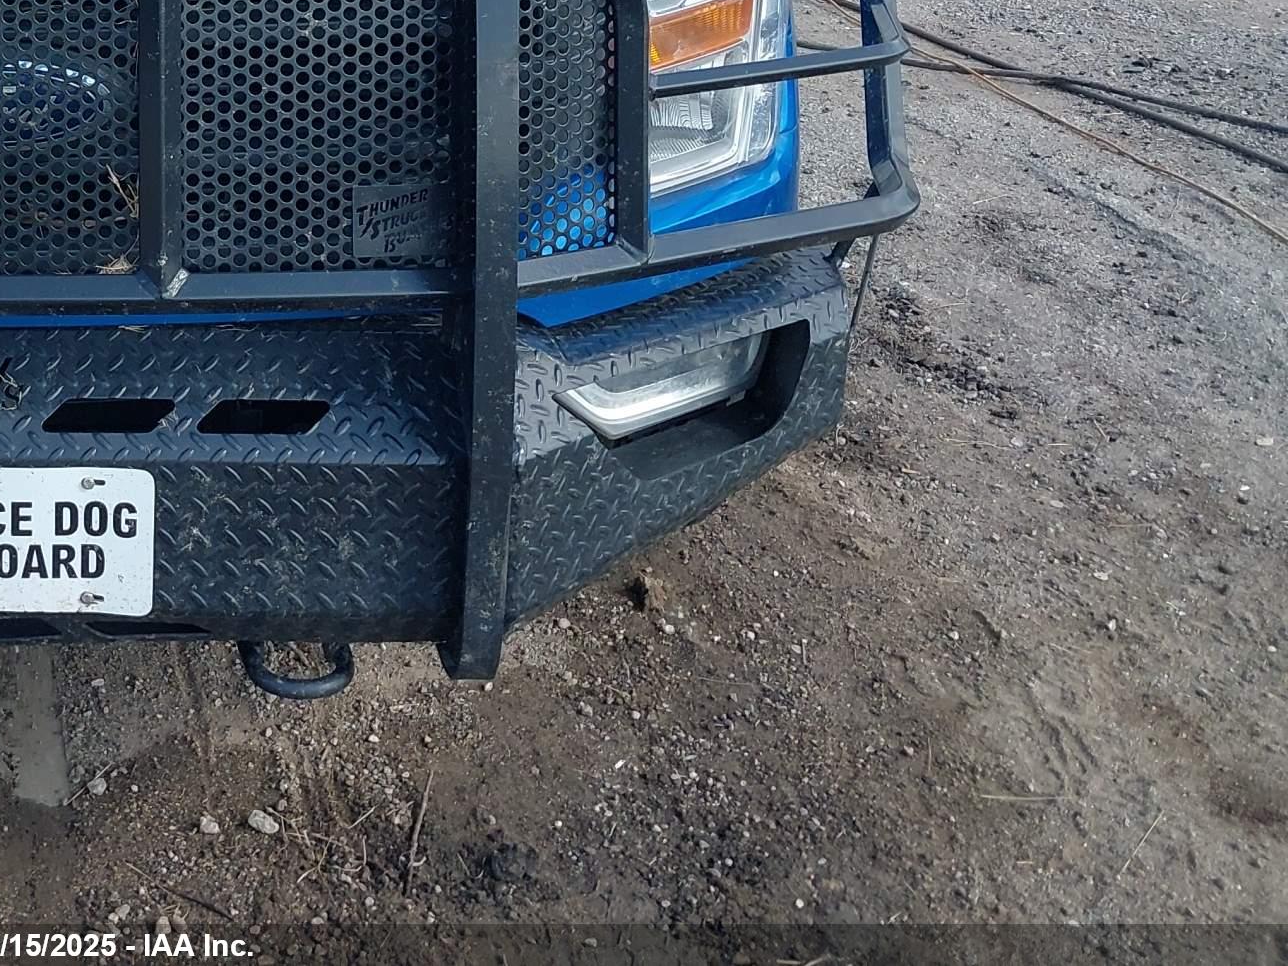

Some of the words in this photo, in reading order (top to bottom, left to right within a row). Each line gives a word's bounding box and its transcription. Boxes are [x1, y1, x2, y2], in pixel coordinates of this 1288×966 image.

[355, 188, 429, 226] THUNDER
[369, 210, 427, 240] STRUC
[54, 500, 139, 539] DOG
